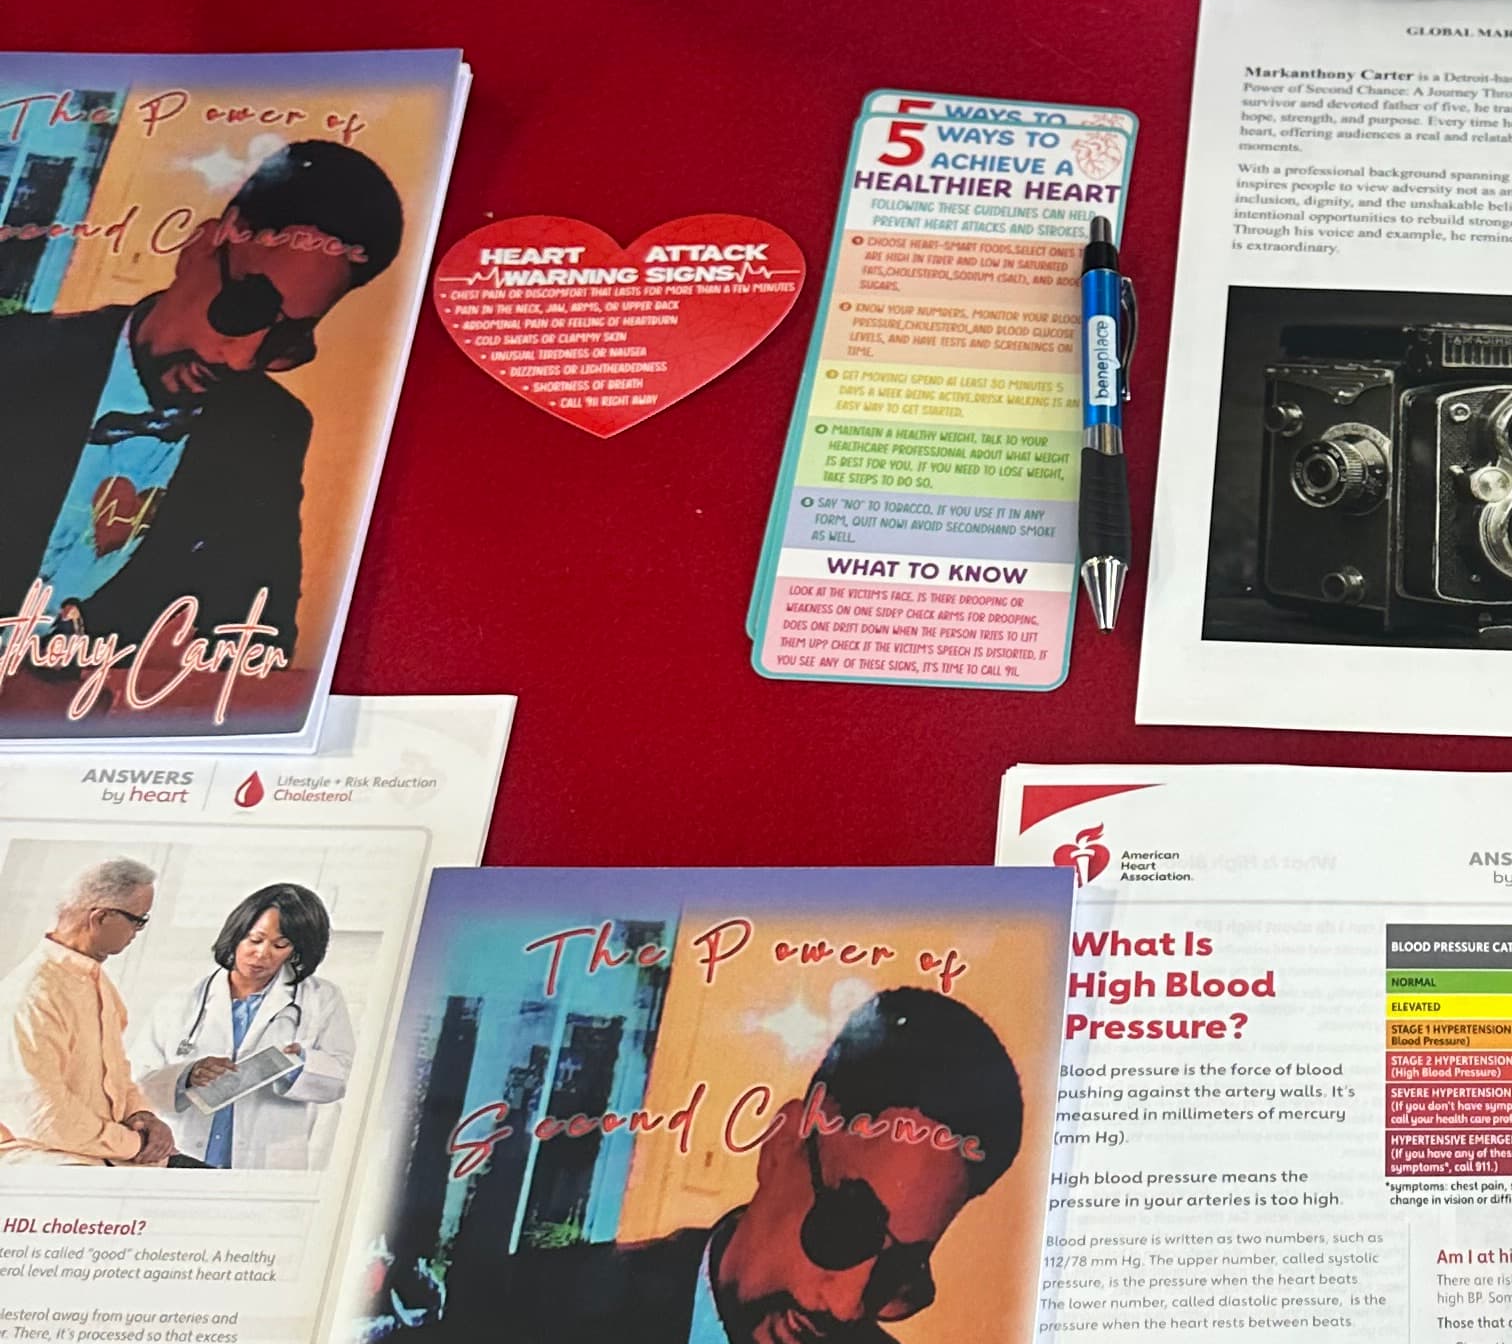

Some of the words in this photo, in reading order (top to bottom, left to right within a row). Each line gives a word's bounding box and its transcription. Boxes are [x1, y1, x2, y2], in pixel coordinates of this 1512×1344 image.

[1405, 26, 1474, 39] GLOBAL
[1244, 65, 1355, 84] Markanthony
[1360, 68, 1414, 83] Carter
[0, 89, 117, 144] The
[326, 112, 368, 147] of
[878, 121, 928, 167] 5
[937, 125, 1014, 147] WAYS
[1026, 132, 1060, 149] TO
[930, 153, 1045, 175] ACHIEVE
[1055, 160, 1074, 177] A
[853, 170, 1012, 198] HEALTHIER
[1025, 182, 1121, 204] HEART
[480, 246, 586, 266] HEART
[644, 243, 769, 263] ATTACK
[501, 267, 638, 287] WARNING
[645, 265, 735, 284] SIGNS
[1096, 320, 1110, 400] beneplace
[827, 557, 896, 577] WHAT
[908, 562, 939, 579] TO
[949, 564, 1028, 585] KNOW
[126, 586, 289, 726] Carter
[81, 769, 193, 785] ANSWERS
[277, 775, 331, 789] Lifestyle
[345, 776, 369, 788] Risk
[372, 776, 437, 788] Reduction
[102, 787, 125, 805] by
[128, 785, 190, 804] heart
[273, 788, 353, 803] Cholesterol
[1121, 851, 1180, 860] American
[1121, 861, 1156, 870] Heart
[1072, 931, 1176, 956] What
[1184, 932, 1213, 956] Is
[1391, 940, 1430, 953] BLOOD
[1433, 940, 1493, 953] PRESSURE
[525, 919, 669, 998] The
[919, 949, 972, 993] of
[1067, 972, 1155, 1004] High
[1166, 972, 1276, 997] Blood
[1391, 977, 1436, 987] NORMAL
[1391, 1002, 1440, 1012] ELEVATED
[1065, 1013, 1248, 1040] Pressure?
[4, 1217, 38, 1235] HDL
[42, 1218, 146, 1237] cholesterol?
[1436, 1247, 1465, 1264] Am
[1468, 1248, 1473, 1263] I
[1477, 1248, 1495, 1264] at
